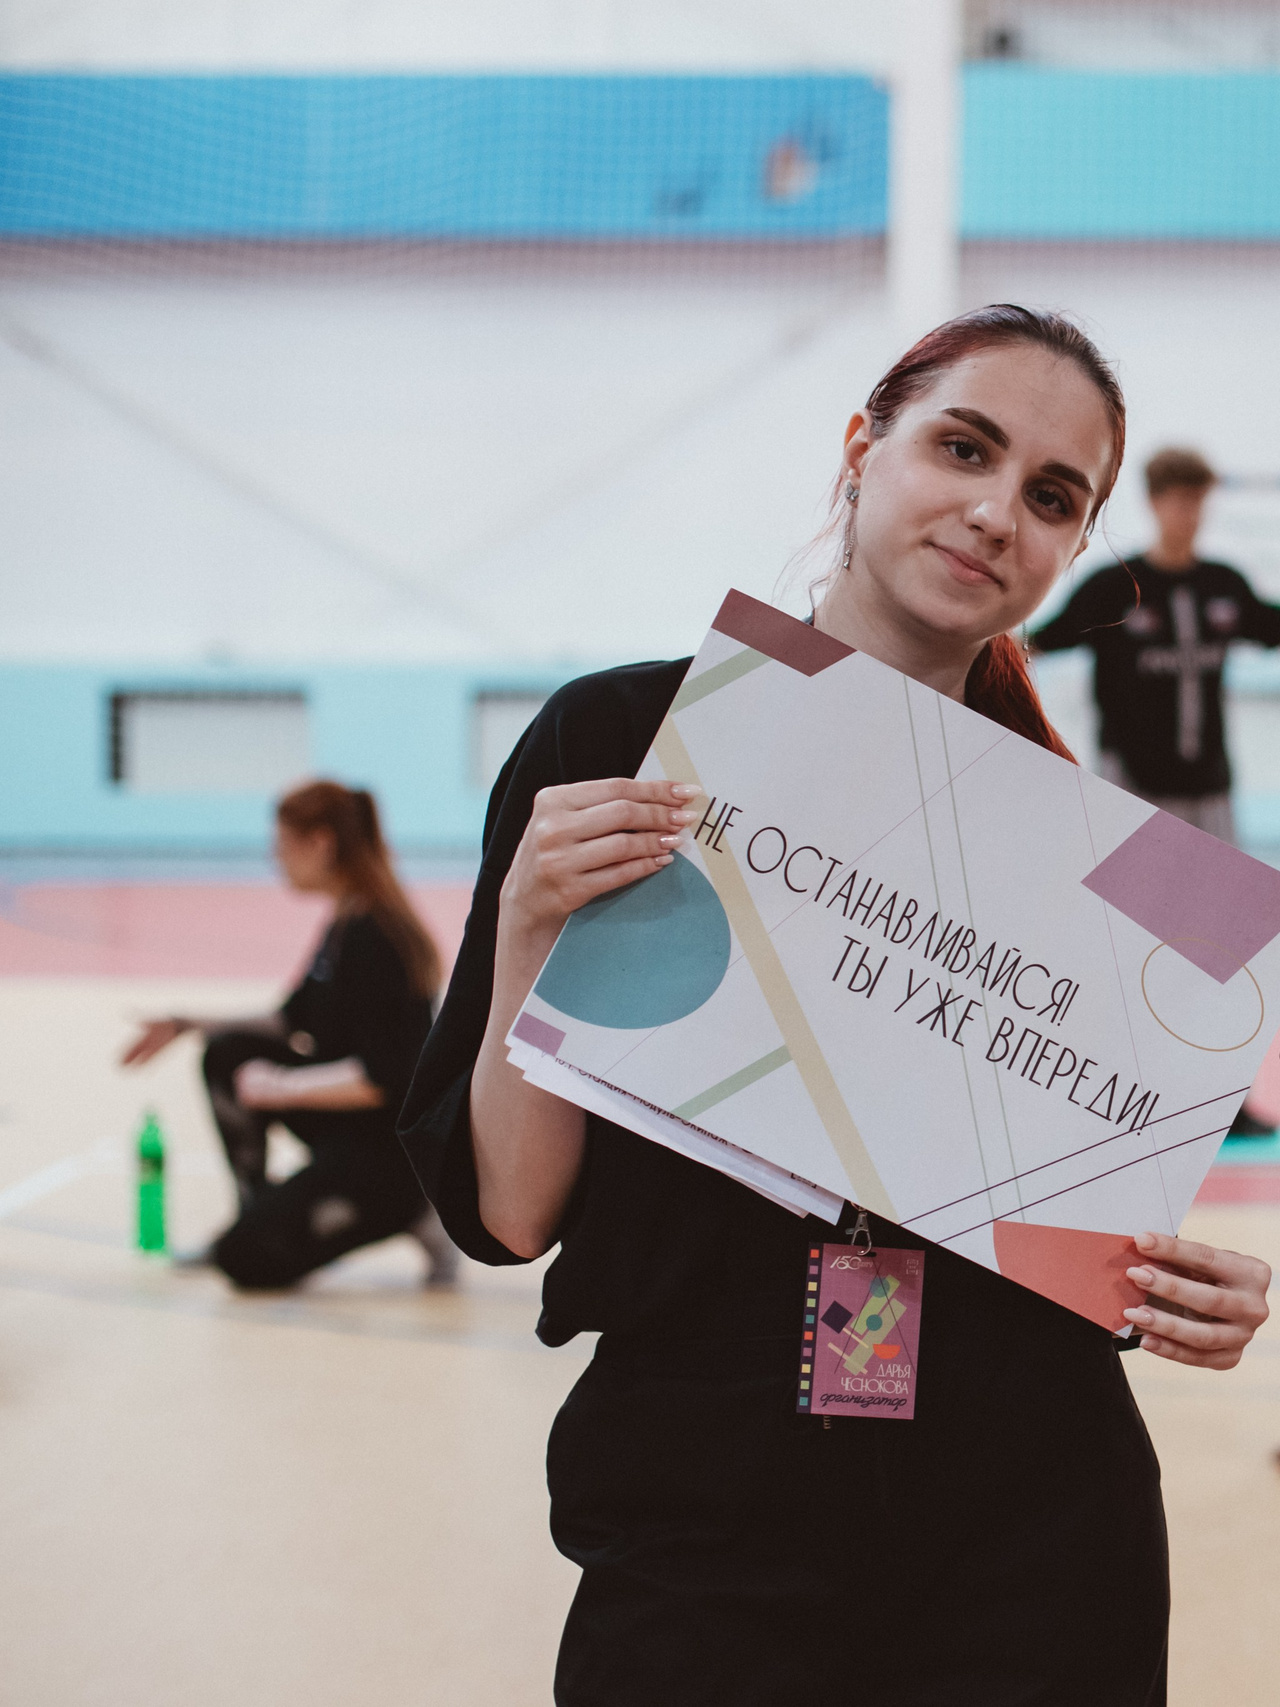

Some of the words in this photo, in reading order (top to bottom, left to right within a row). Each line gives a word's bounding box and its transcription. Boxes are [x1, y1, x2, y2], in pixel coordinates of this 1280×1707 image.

[693, 796, 743, 854] НЕ
[746, 826, 1080, 1027] ОСТАНАВЛИВАЙСЯ!
[831, 935, 889, 1000] ТЫ
[893, 968, 984, 1048] УЖЕ
[985, 1016, 1160, 1137] ВПЕРЕДИ!
[876, 1363, 912, 1379] ДАРЬЯ
[840, 1377, 910, 1395] ЧЕСНОКОВА
[820, 1393, 908, 1412] организатор
